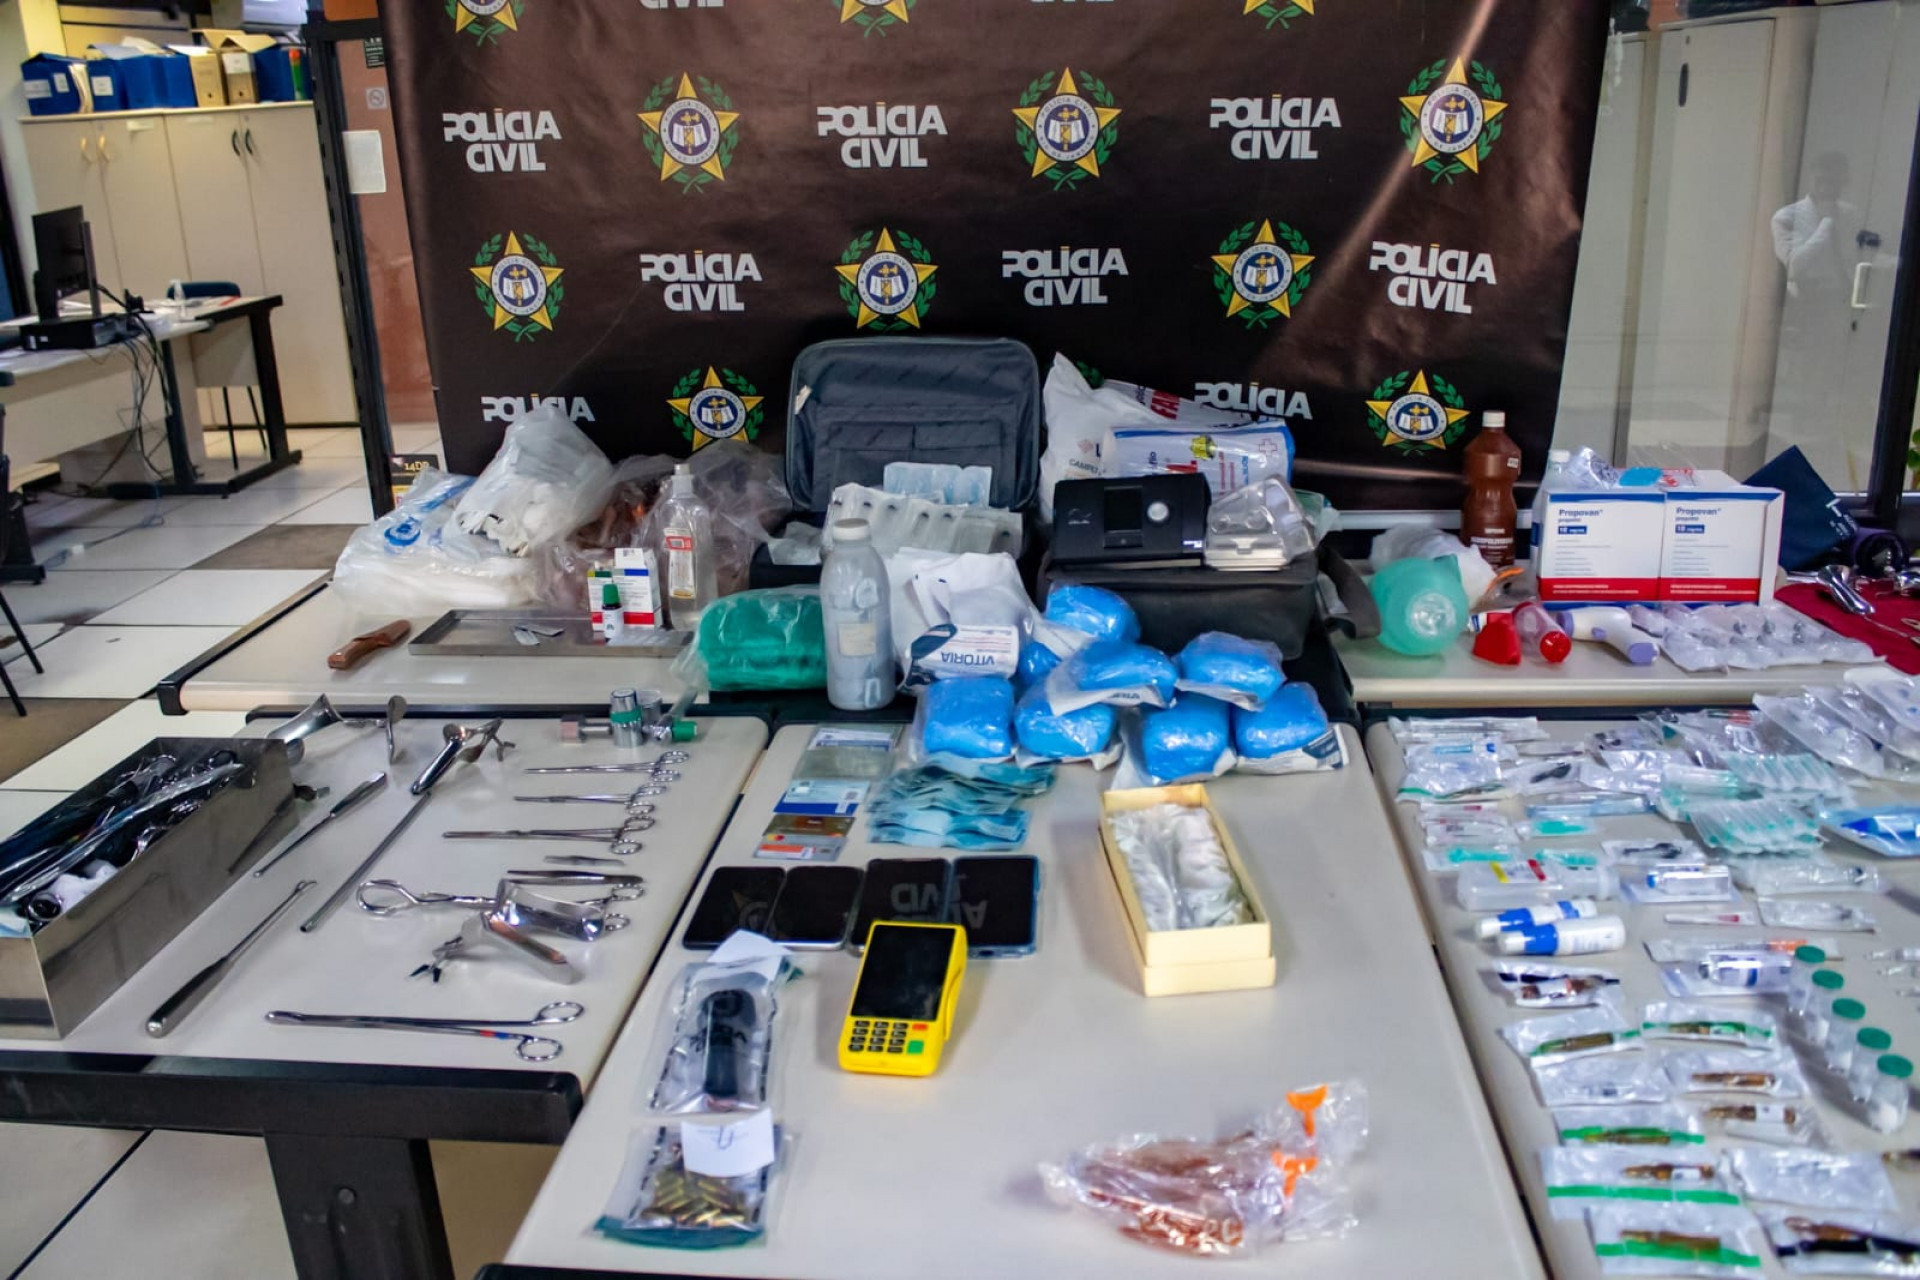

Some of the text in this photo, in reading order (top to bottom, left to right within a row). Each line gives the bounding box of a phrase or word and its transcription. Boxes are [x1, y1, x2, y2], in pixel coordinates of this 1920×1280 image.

[465, 142, 547, 173] CIVIL
[840, 137, 929, 168] CIVIL
[1230, 130, 1319, 160] CIVIL
[663, 283, 746, 312] CIVIL
[1024, 278, 1108, 307] CIVIL
[1387, 275, 1473, 314] CIVIL
